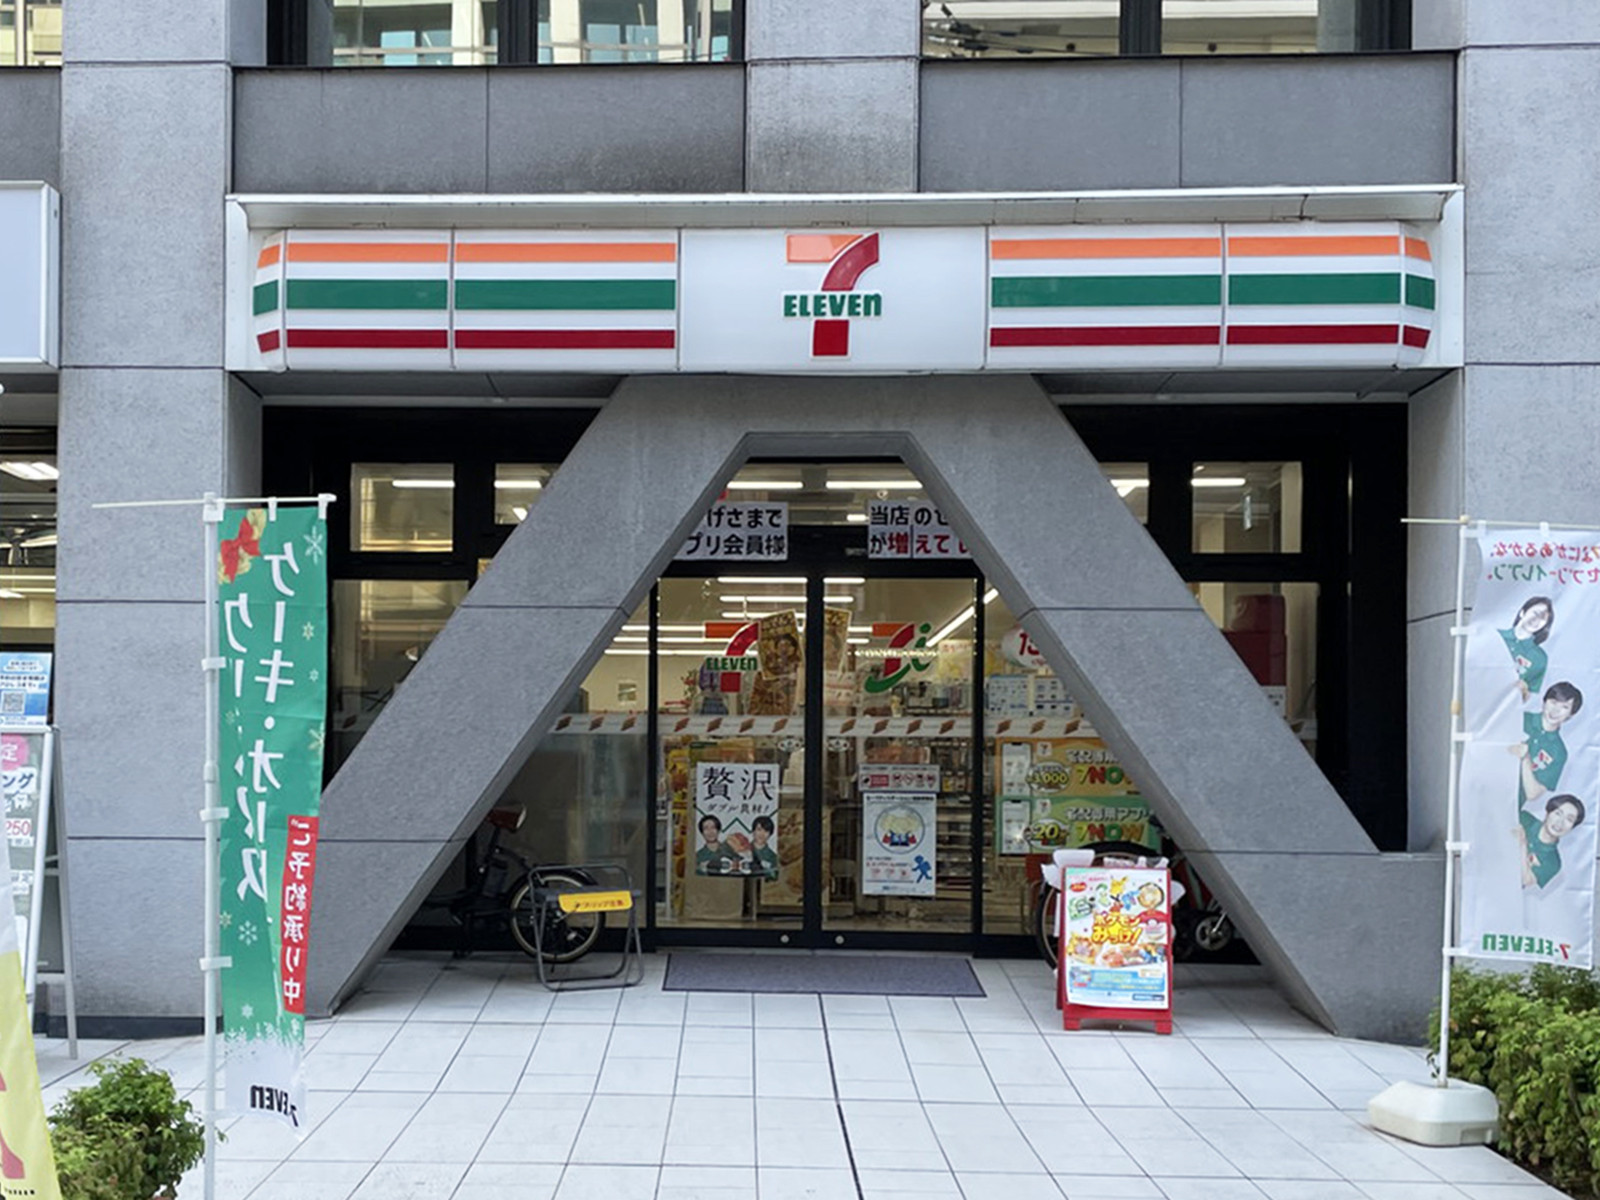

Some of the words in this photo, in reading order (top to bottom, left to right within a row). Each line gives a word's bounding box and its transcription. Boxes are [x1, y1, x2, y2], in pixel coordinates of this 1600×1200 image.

[707, 505, 782, 529] げさまで
[686, 532, 785, 556] プリ会員様
[702, 767, 773, 801] 贅沢
[1076, 766, 1133, 785] 7NO
